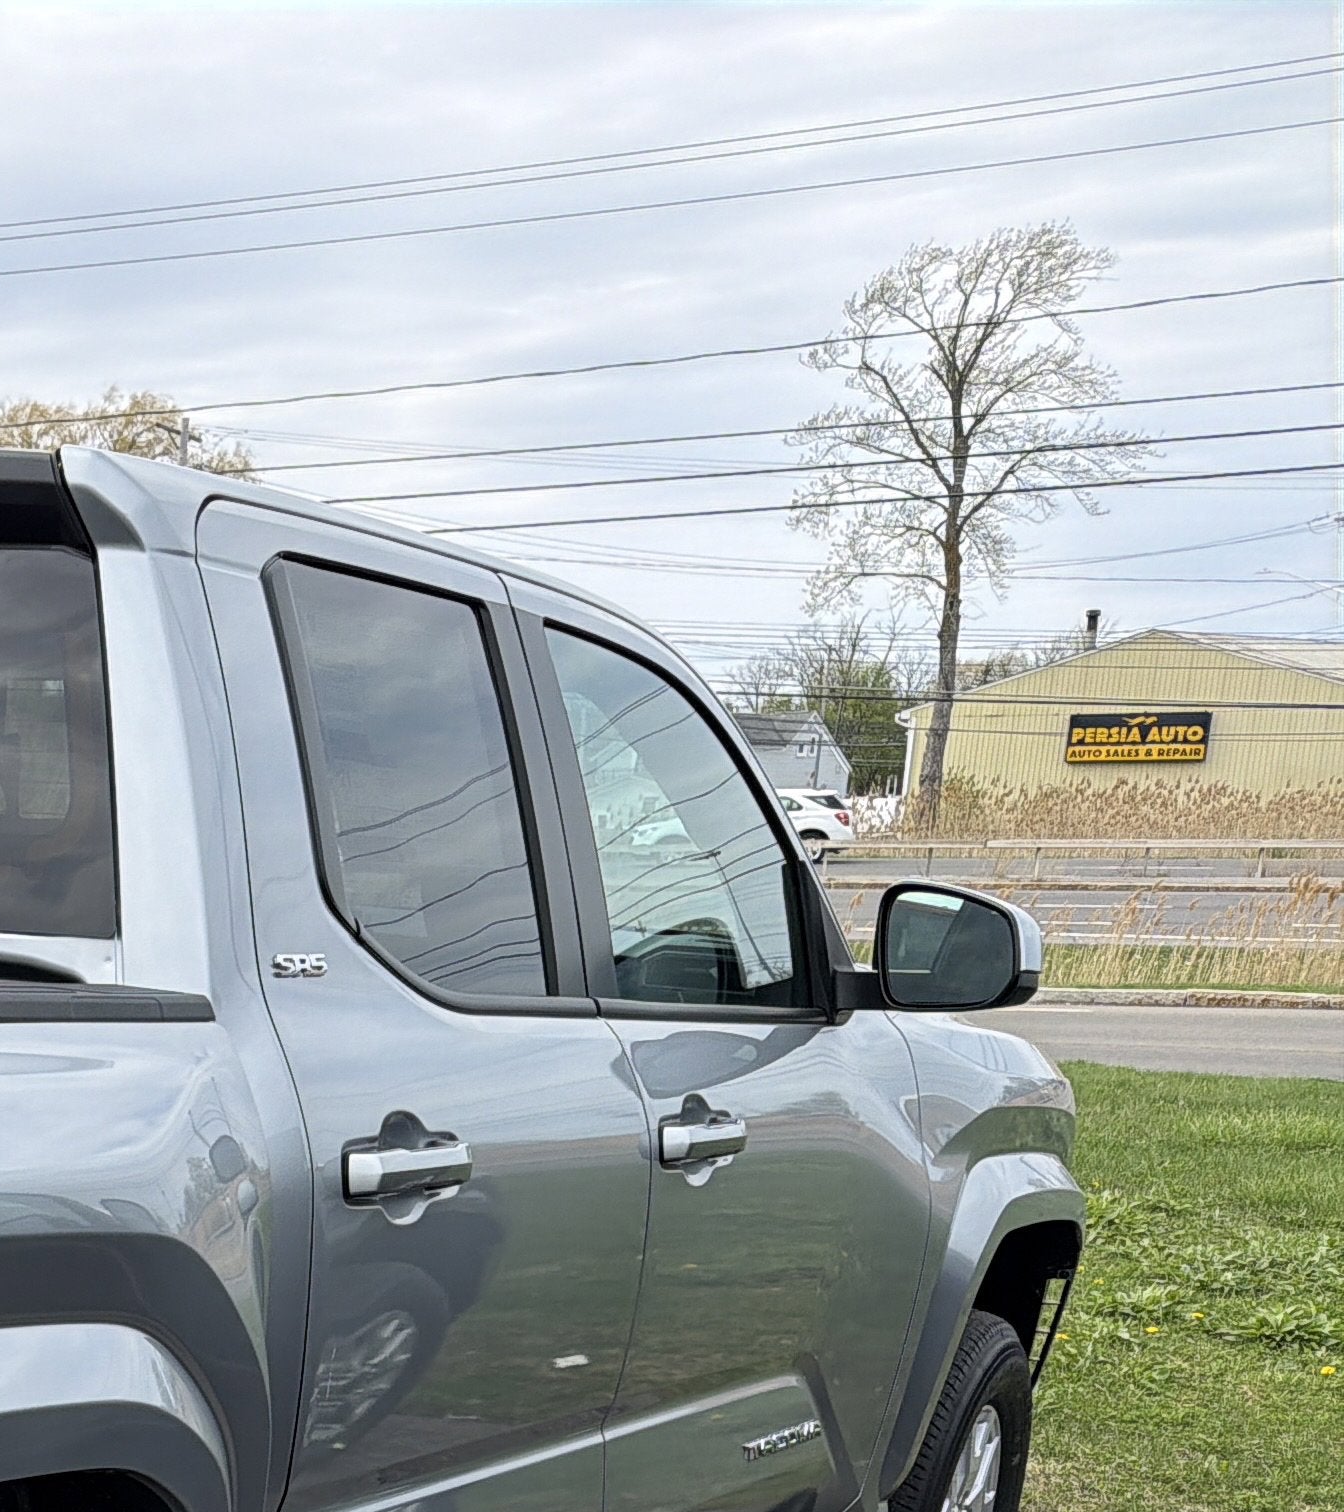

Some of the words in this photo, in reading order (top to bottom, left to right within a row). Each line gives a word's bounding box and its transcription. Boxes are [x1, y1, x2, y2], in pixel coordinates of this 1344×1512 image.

[1070, 726, 1142, 744] PERSIA
[1145, 725, 1205, 743] AUTO
[1069, 749, 1103, 759] AUTO
[1105, 748, 1140, 758] SALES
[1145, 748, 1154, 757] &
[1157, 747, 1202, 757] REPAIR
[272, 953, 328, 978] SR5
[741, 1418, 824, 1462] TACOMA
